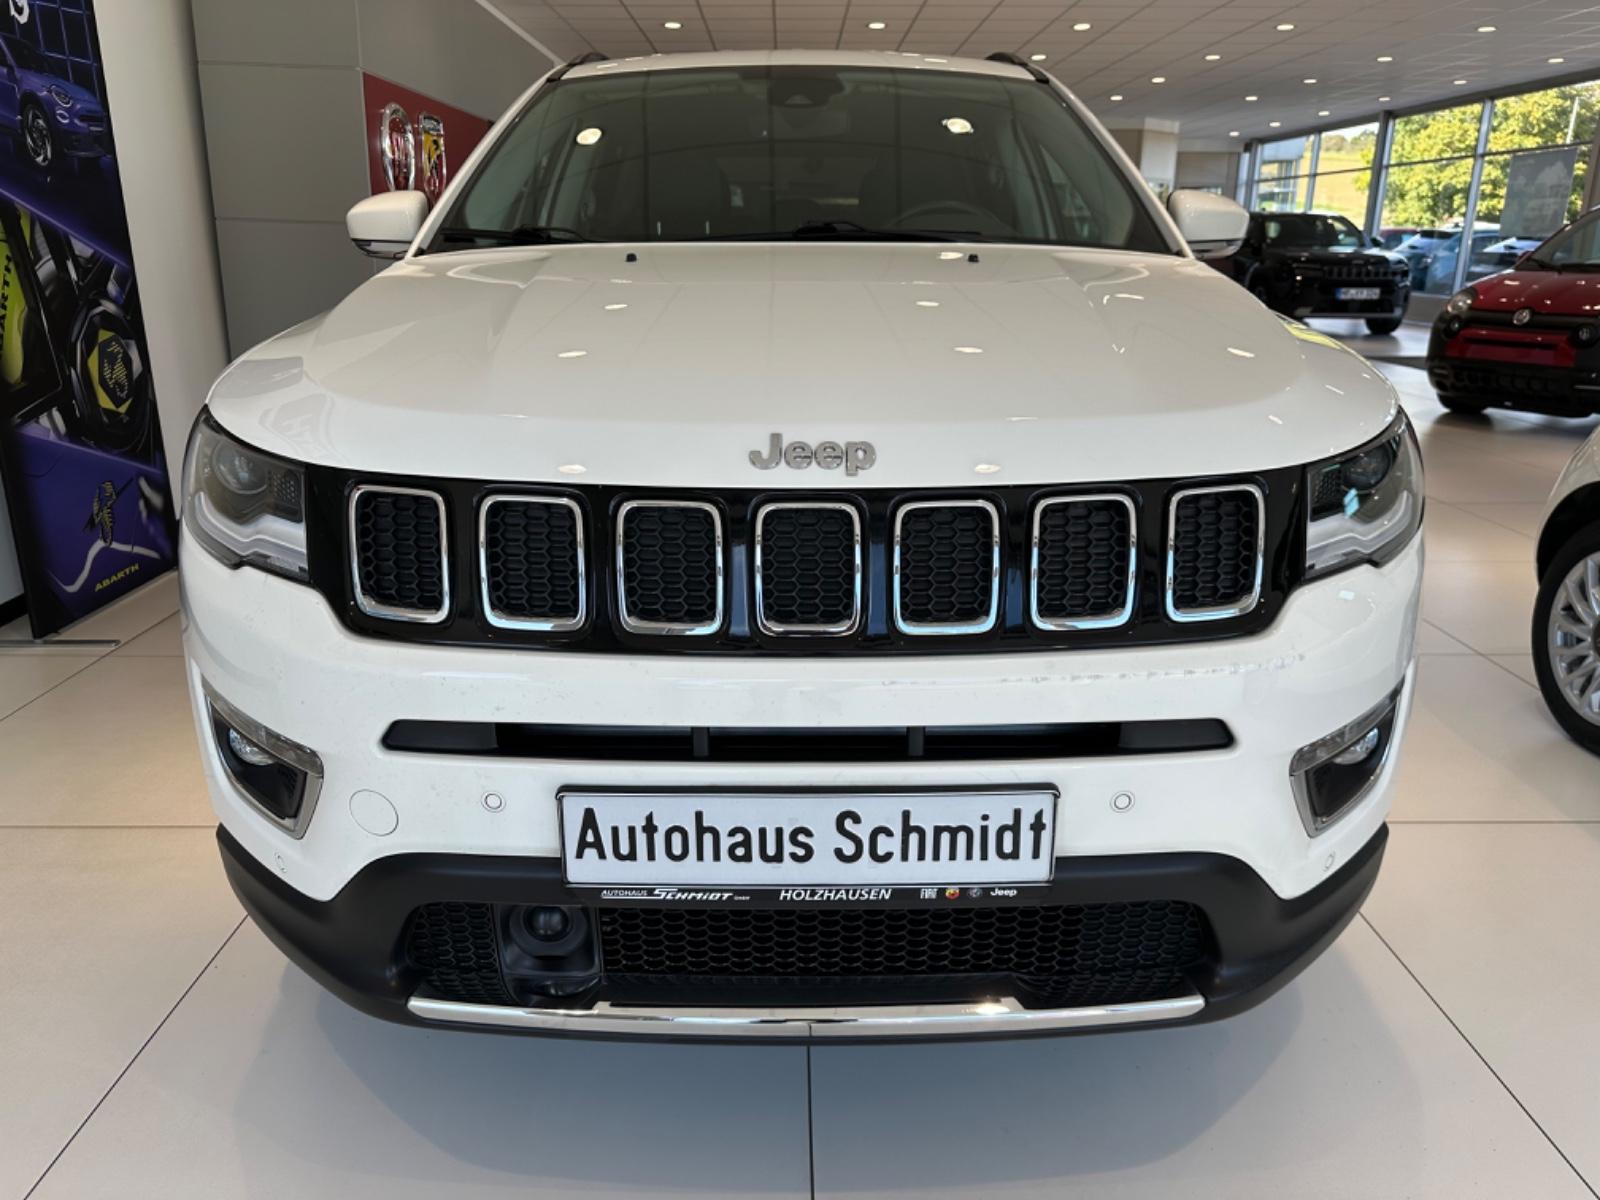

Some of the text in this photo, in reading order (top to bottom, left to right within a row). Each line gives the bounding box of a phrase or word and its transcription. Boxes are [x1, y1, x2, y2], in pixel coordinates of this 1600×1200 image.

[748, 432, 876, 476] Jeep
[94, 562, 140, 593] ABARTH
[575, 807, 1047, 863] Autohaus Schmidt
[601, 889, 648, 897] AUTOHAUS
[779, 888, 892, 900] HOLZHAUSEN
[919, 888, 938, 900] FIAT
[990, 887, 1018, 898] Jeep
